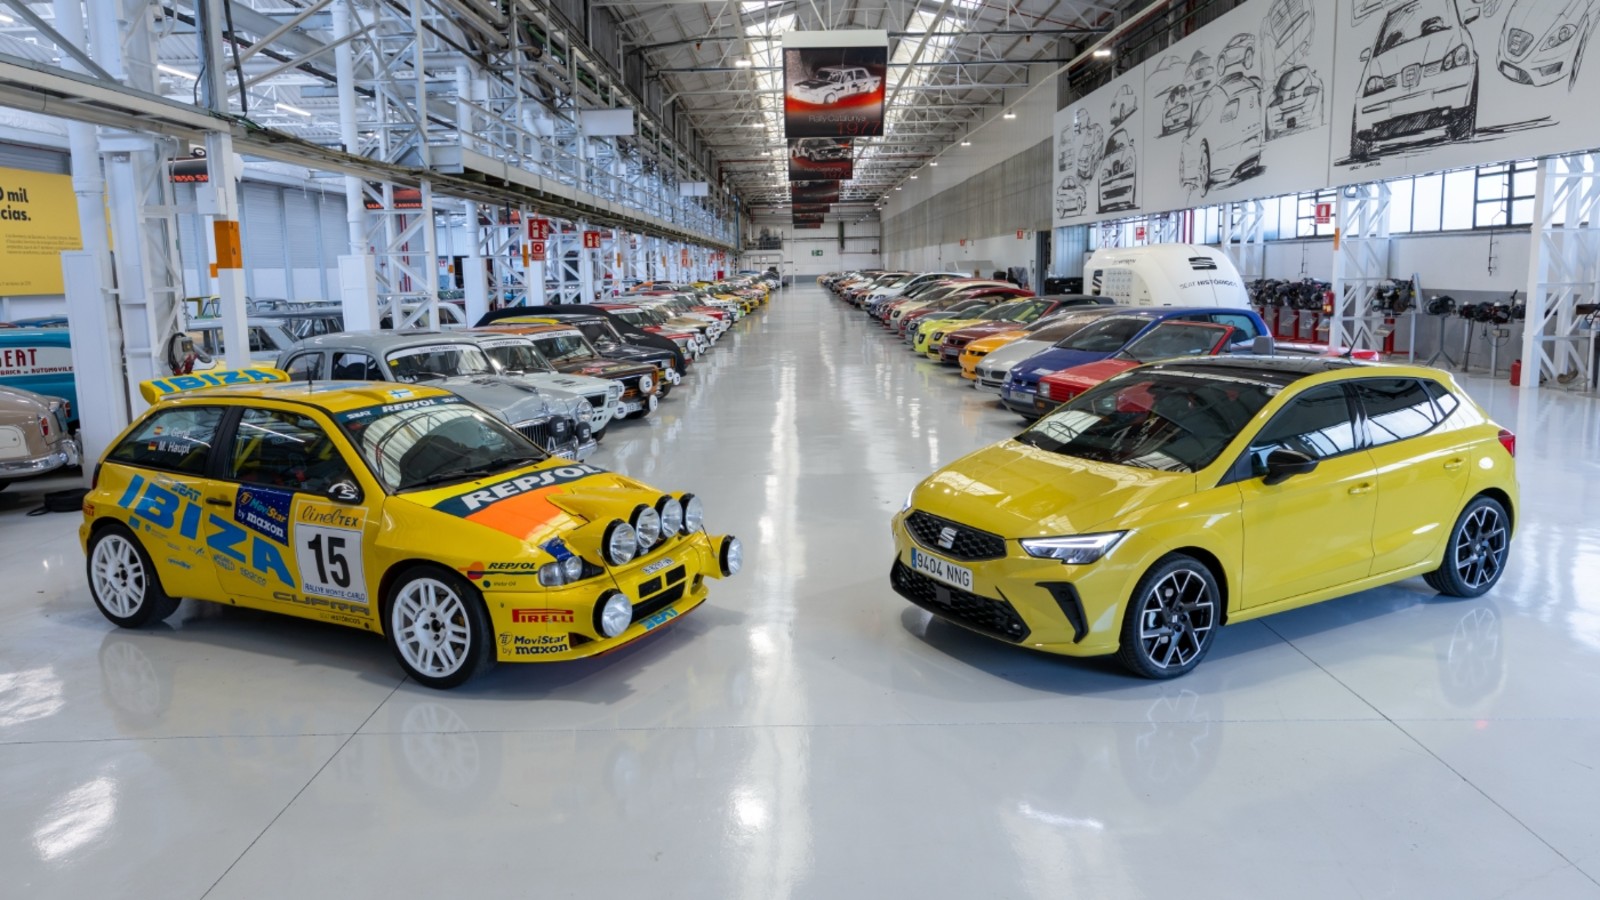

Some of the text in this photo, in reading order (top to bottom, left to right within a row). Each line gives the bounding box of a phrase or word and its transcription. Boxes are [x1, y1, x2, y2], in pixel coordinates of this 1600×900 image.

[837, 121, 881, 135] 1977
[7, 186, 29, 204] mil
[0, 204, 31, 221] cias.
[152, 369, 279, 393] IBIZA
[381, 399, 437, 413] REPSOL
[171, 482, 202, 502] SEAT
[461, 465, 603, 511] REPSOL
[250, 496, 288, 523] MoviStar
[117, 474, 296, 589] IBIZA
[237, 509, 284, 538] by maxon
[308, 533, 351, 588] 15
[487, 562, 536, 570] REPSOL
[917, 553, 970, 587] 9404 NNG
[304, 583, 366, 601] RALLYE MONTE-CARLO
[273, 591, 371, 617] CUPRA
[512, 608, 574, 623] PIRELLI
[502, 643, 569, 656] by maxon
[514, 635, 568, 645] MoviStar
